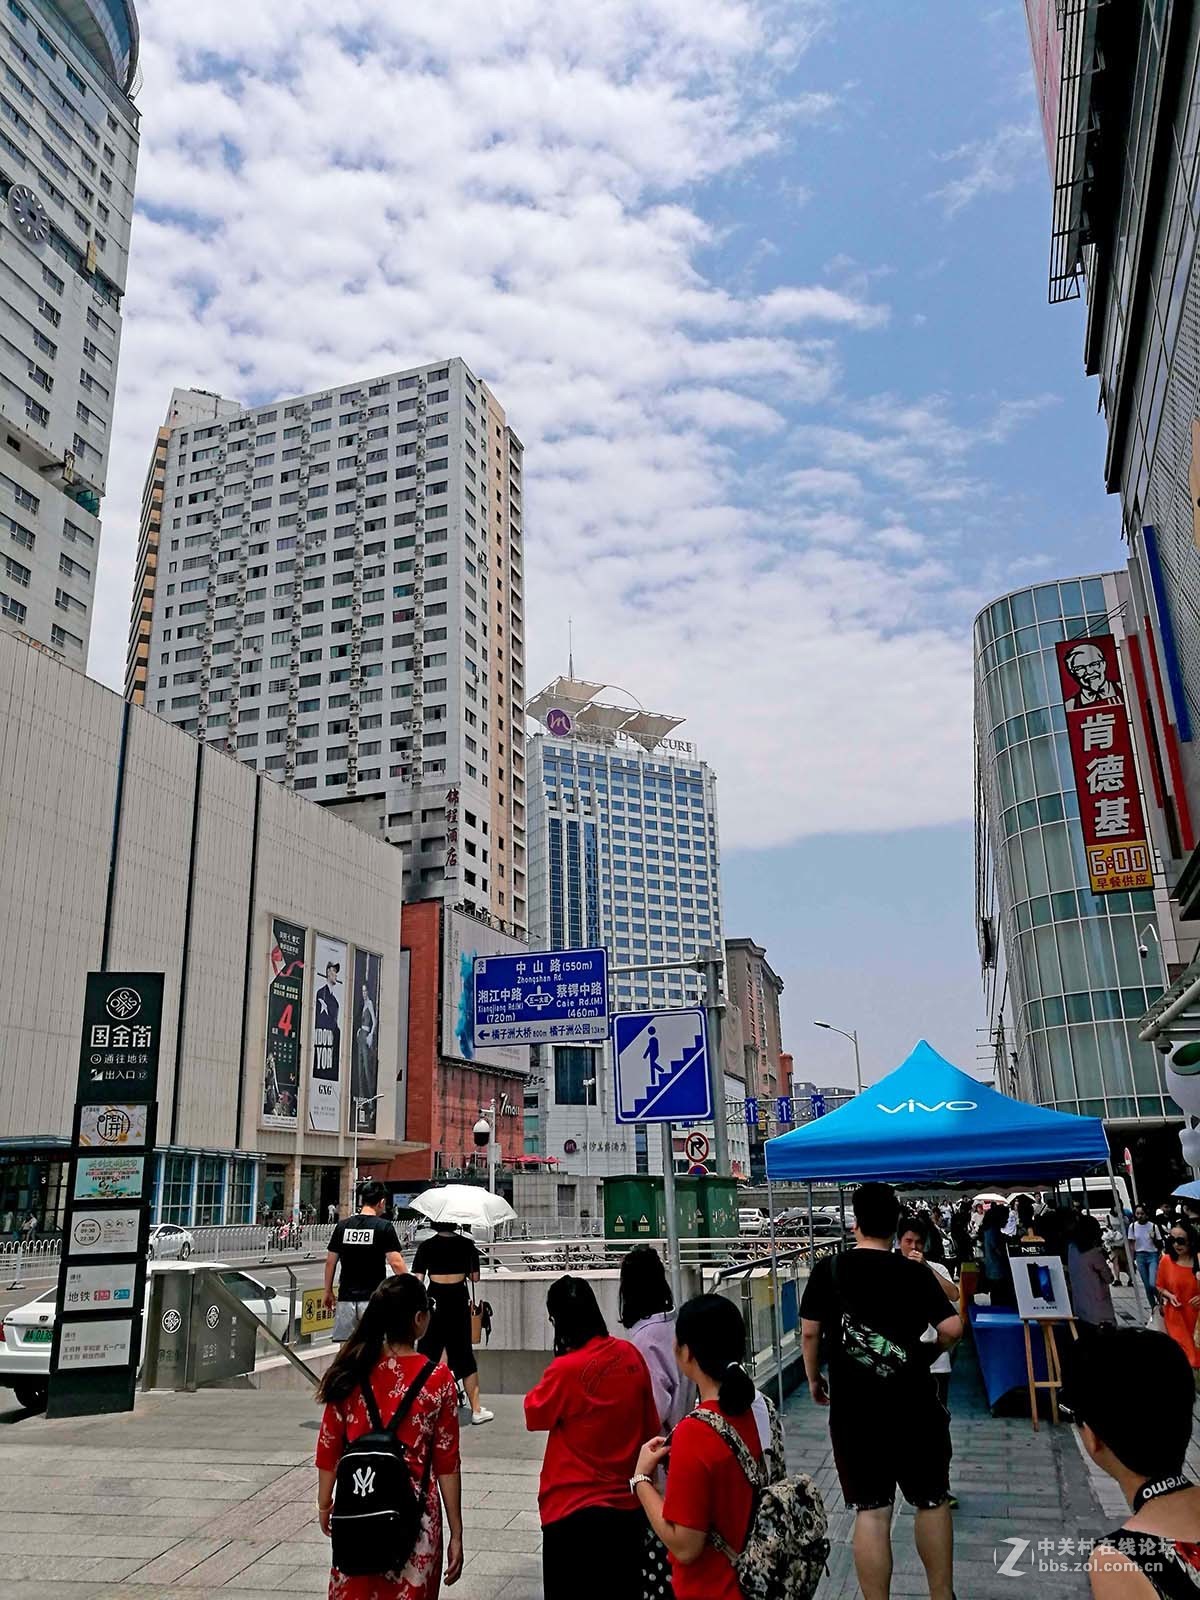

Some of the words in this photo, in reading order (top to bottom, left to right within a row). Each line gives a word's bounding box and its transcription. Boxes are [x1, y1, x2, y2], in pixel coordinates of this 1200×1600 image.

[1080, 712, 1130, 838] 肯德基
[1089, 845, 1149, 876] 6:00
[1096, 873, 1148, 889] 早餐供应
[516, 958, 562, 975] 中山路
[562, 961, 593, 972] (550m)
[517, 975, 551, 985] Zhongshan
[553, 973, 563, 982] Rd.
[478, 987, 523, 1003] 湘江中路
[556, 981, 603, 998] 蔡锷中路
[486, 1011, 516, 1024] (720m)
[568, 1007, 599, 1018] (460m)
[278, 1003, 294, 1038] 4
[90, 1024, 152, 1048] 国金街
[491, 1026, 532, 1041] 橘子洲大桥
[549, 1023, 591, 1038] 橘子洲公园
[104, 1053, 149, 1065] 通往地铁
[104, 1069, 136, 1080] 出入口
[876, 1098, 978, 1114] vivo
[346, 1231, 370, 1242] 1978
[68, 1290, 91, 1303] 地铁
